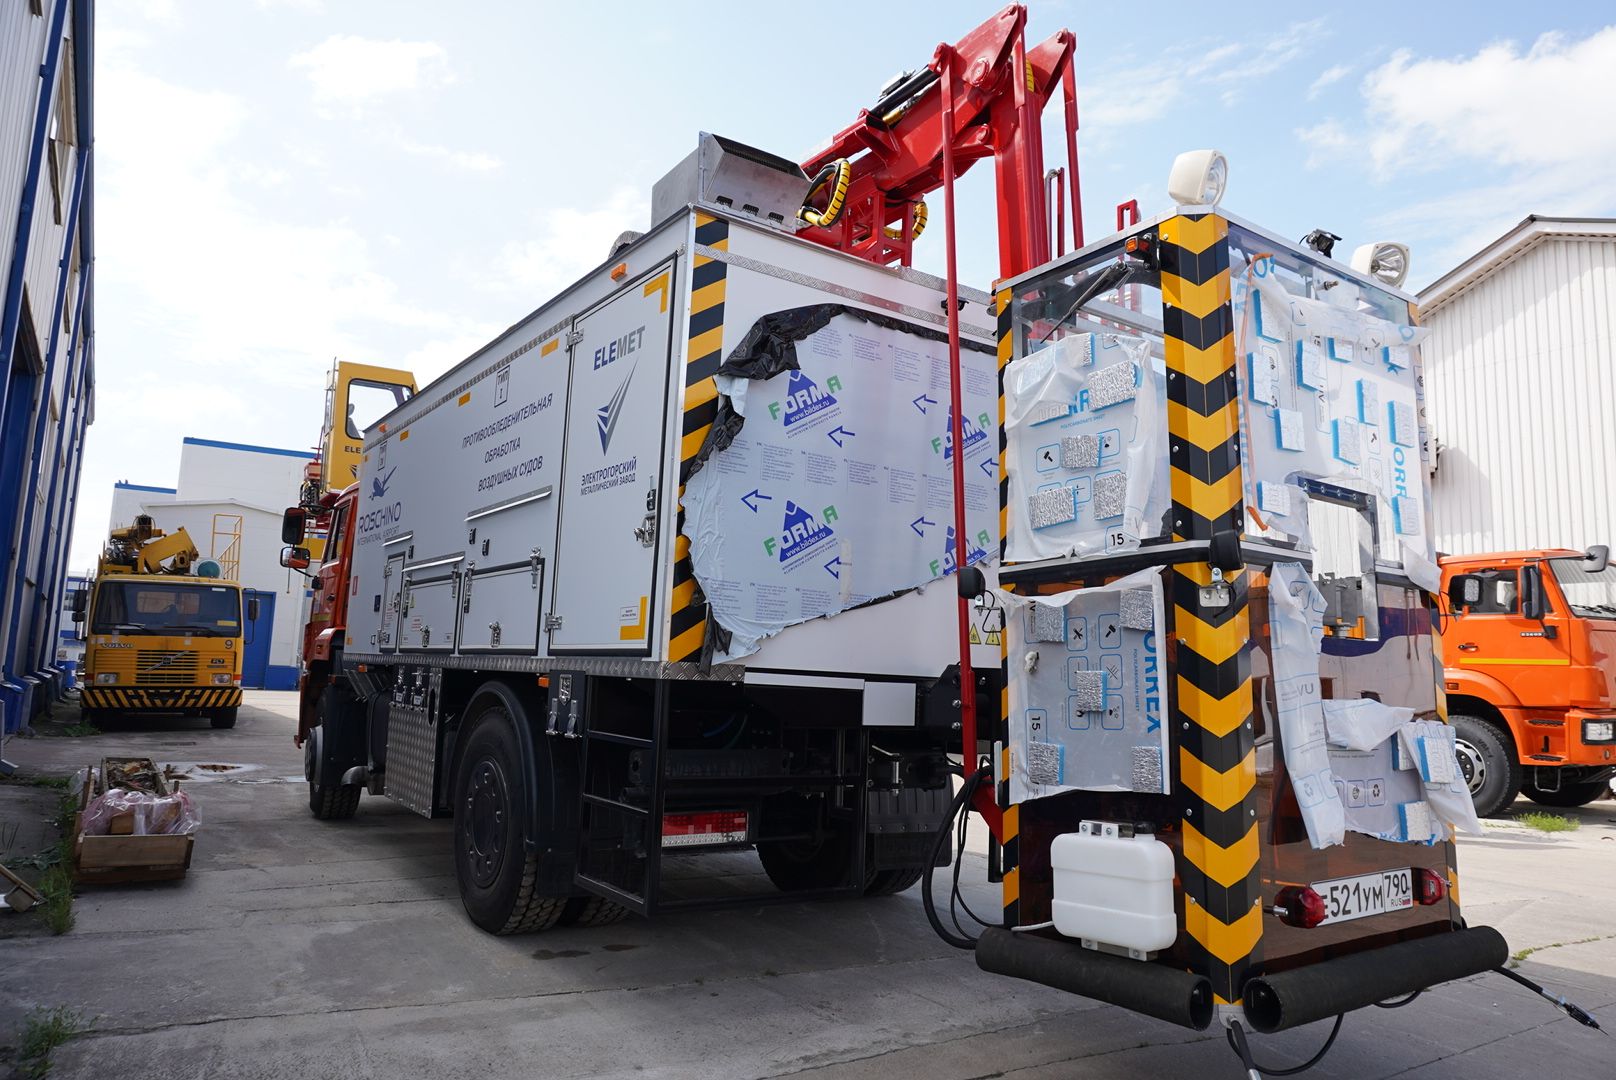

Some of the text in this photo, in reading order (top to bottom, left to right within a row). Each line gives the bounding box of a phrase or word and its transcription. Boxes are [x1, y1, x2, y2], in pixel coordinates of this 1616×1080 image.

[593, 325, 646, 371] ELEMET
[497, 370, 509, 386] ТИП
[768, 375, 842, 421] FORMA
[462, 393, 553, 449] ПРОТИВООБЛЕДЕНИТЕЛЬНАЯ
[789, 401, 831, 423] www.bildex.ru
[931, 412, 992, 455] FOMA
[344, 445, 361, 454] ELE
[484, 437, 521, 464] ОБРАБОТКА
[478, 456, 544, 492] ВОЗДУШНЫХ СУДОВ
[580, 472, 636, 497] МЕТАЛЛИЧЕСКИЙ ЗАВОД
[581, 456, 637, 487] ЭЛЕКТРОГОРСКИЙ
[1393, 447, 1408, 498] ORR
[358, 502, 402, 534] ROSCHINO
[763, 505, 838, 558] FORMA
[785, 531, 827, 558] www.bildex.ru
[929, 529, 991, 577] FOMA
[1111, 533, 1125, 546] 15
[102, 641, 134, 649] VOLVO
[225, 639, 233, 650] 9
[1143, 632, 1161, 734] ORREX
[1031, 716, 1041, 731] 15
[1384, 872, 1409, 899] 790
[1390, 898, 1402, 907] RUS
